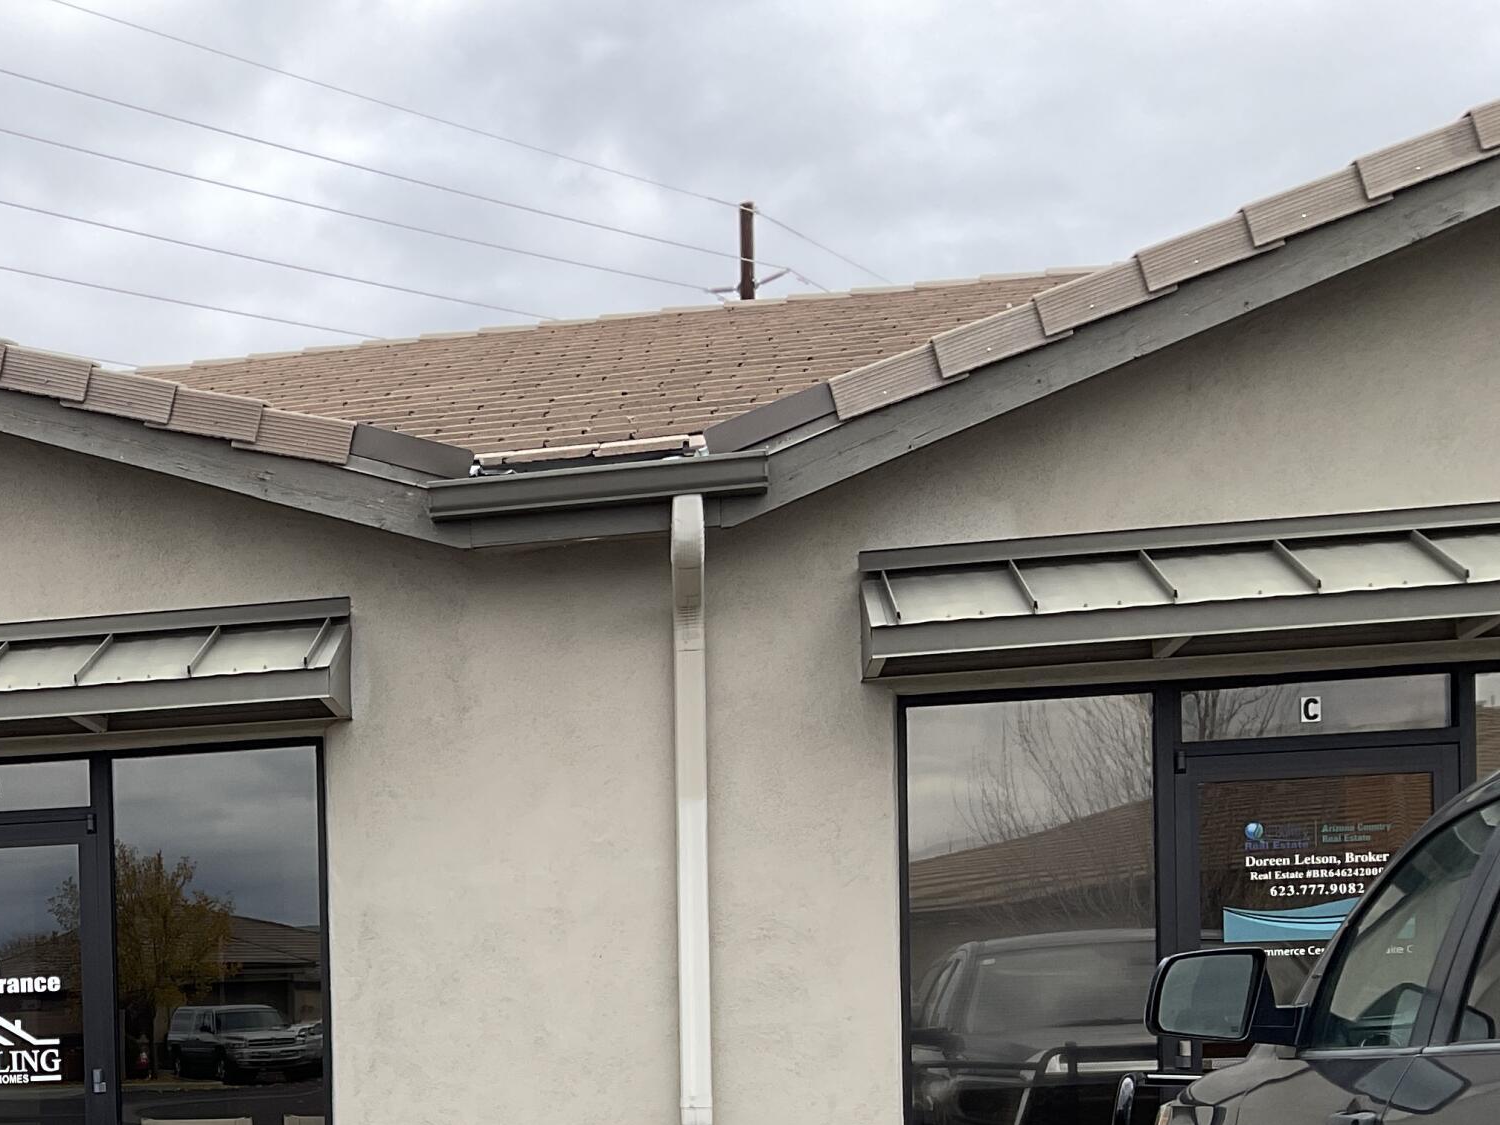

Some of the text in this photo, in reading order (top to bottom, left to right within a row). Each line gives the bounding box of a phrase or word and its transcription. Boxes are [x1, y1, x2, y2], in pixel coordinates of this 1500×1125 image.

[1303, 698, 1319, 720] C
[1245, 855, 1290, 868] Doreen
[1344, 851, 1390, 864] Broker
[1249, 871, 1272, 881] Real
[1274, 870, 1304, 880] Estate
[1269, 882, 1365, 897] 623.777.9082
